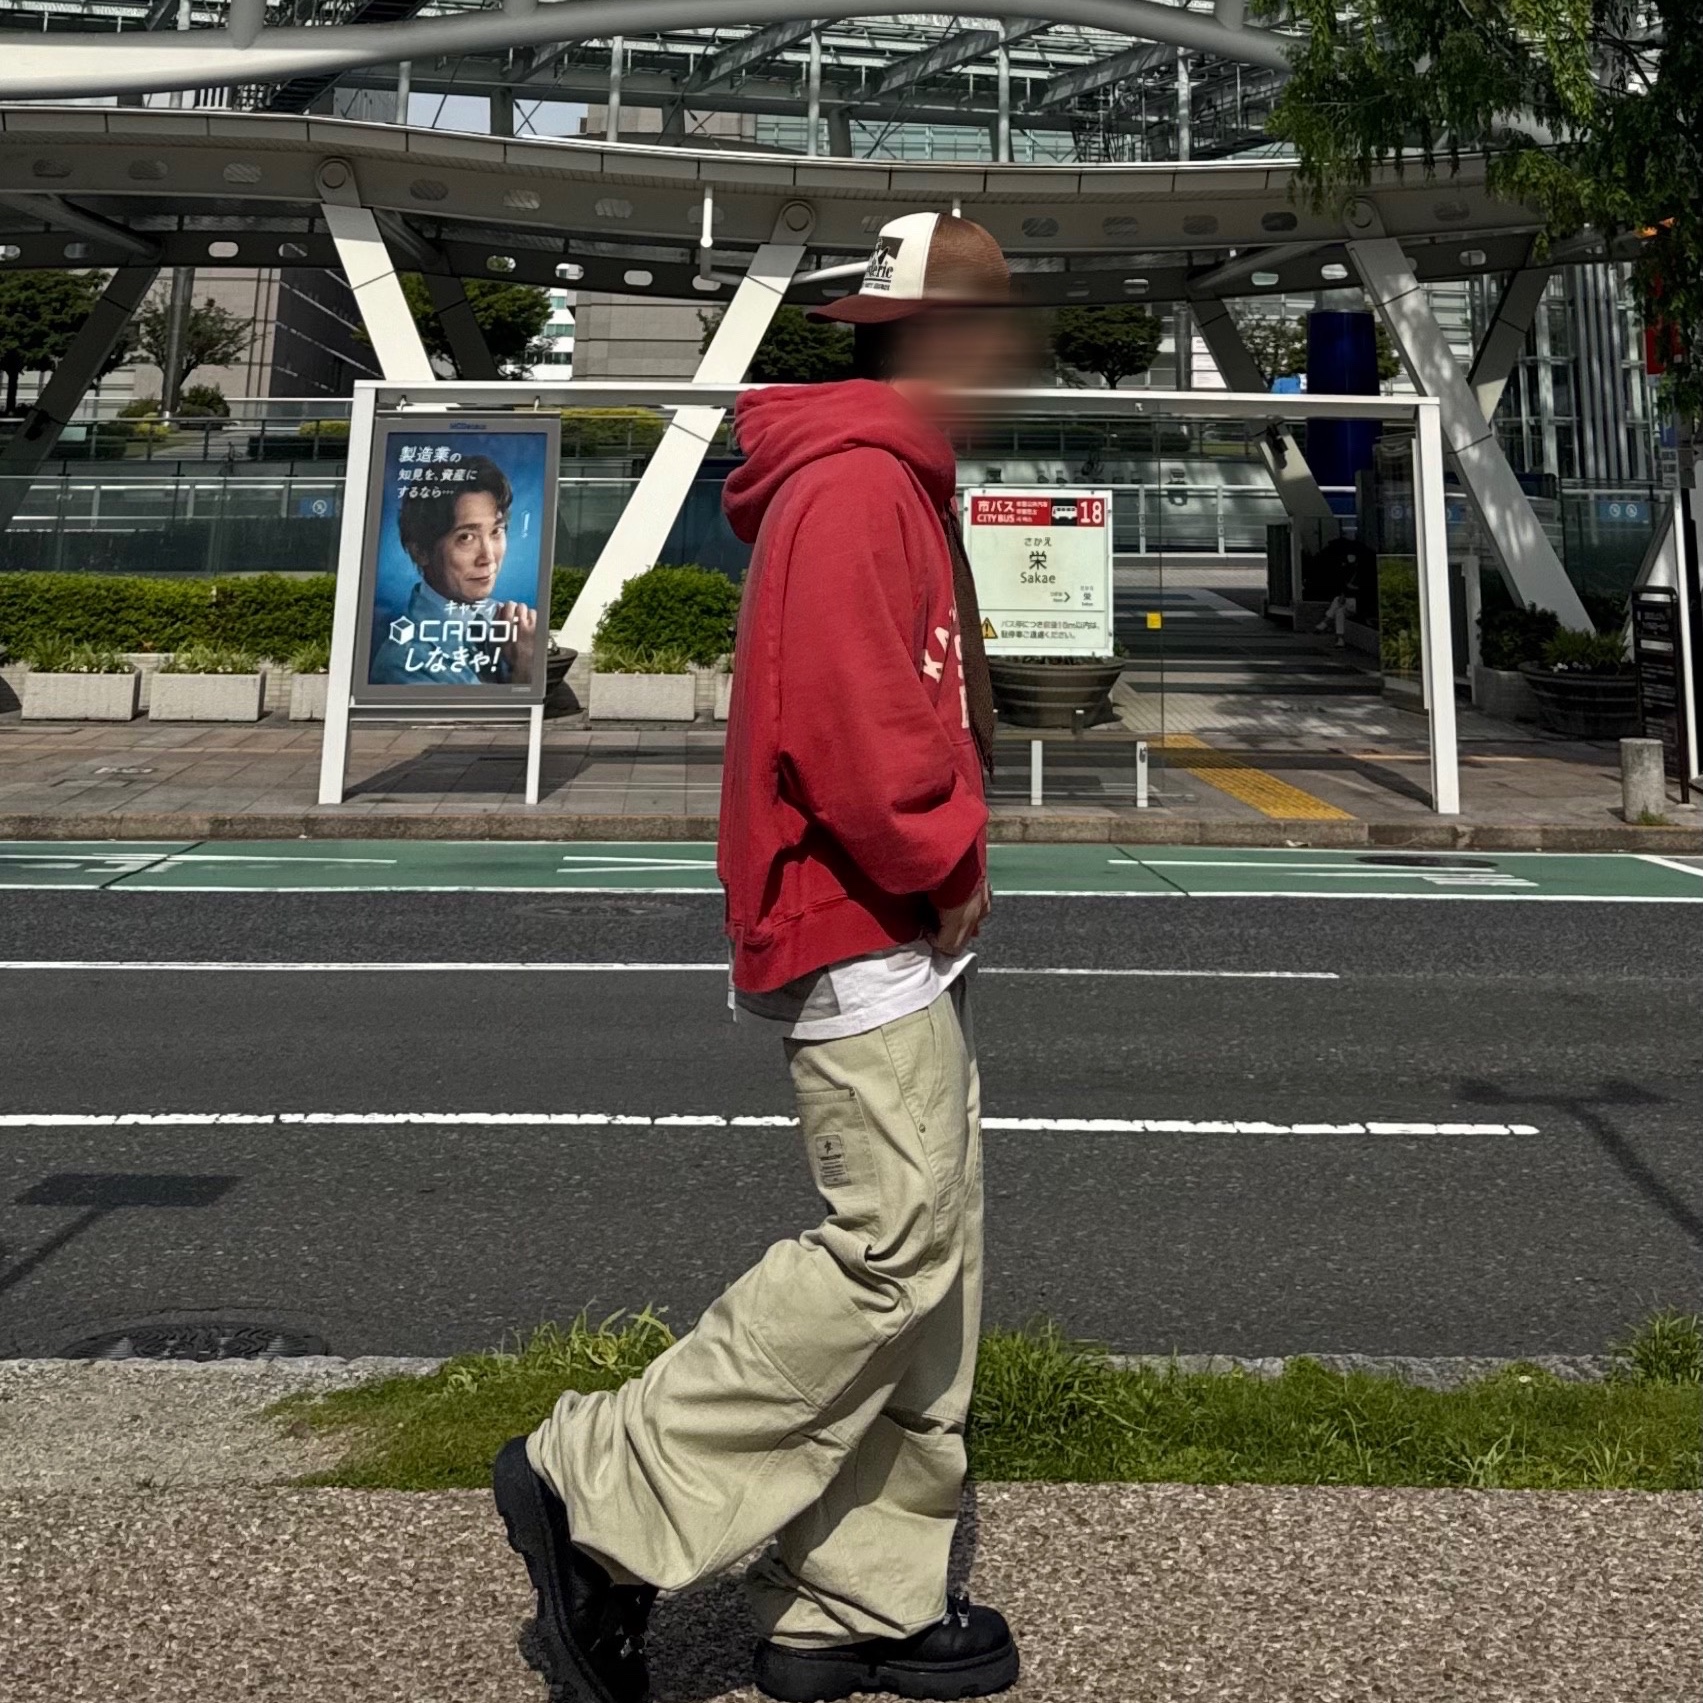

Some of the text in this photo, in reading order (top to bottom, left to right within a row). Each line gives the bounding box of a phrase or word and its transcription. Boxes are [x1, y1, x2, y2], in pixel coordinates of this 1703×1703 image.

[398, 445, 462, 464] 製造業の
[397, 468, 478, 482] 知見を、資産に
[977, 500, 1015, 513] 市バス
[1080, 501, 1102, 523] 18
[976, 513, 997, 523] CITY
[998, 513, 1015, 523] BUS
[1024, 537, 1052, 547] さかえ
[1029, 550, 1047, 570] 栄
[1020, 572, 1056, 584] Sakae
